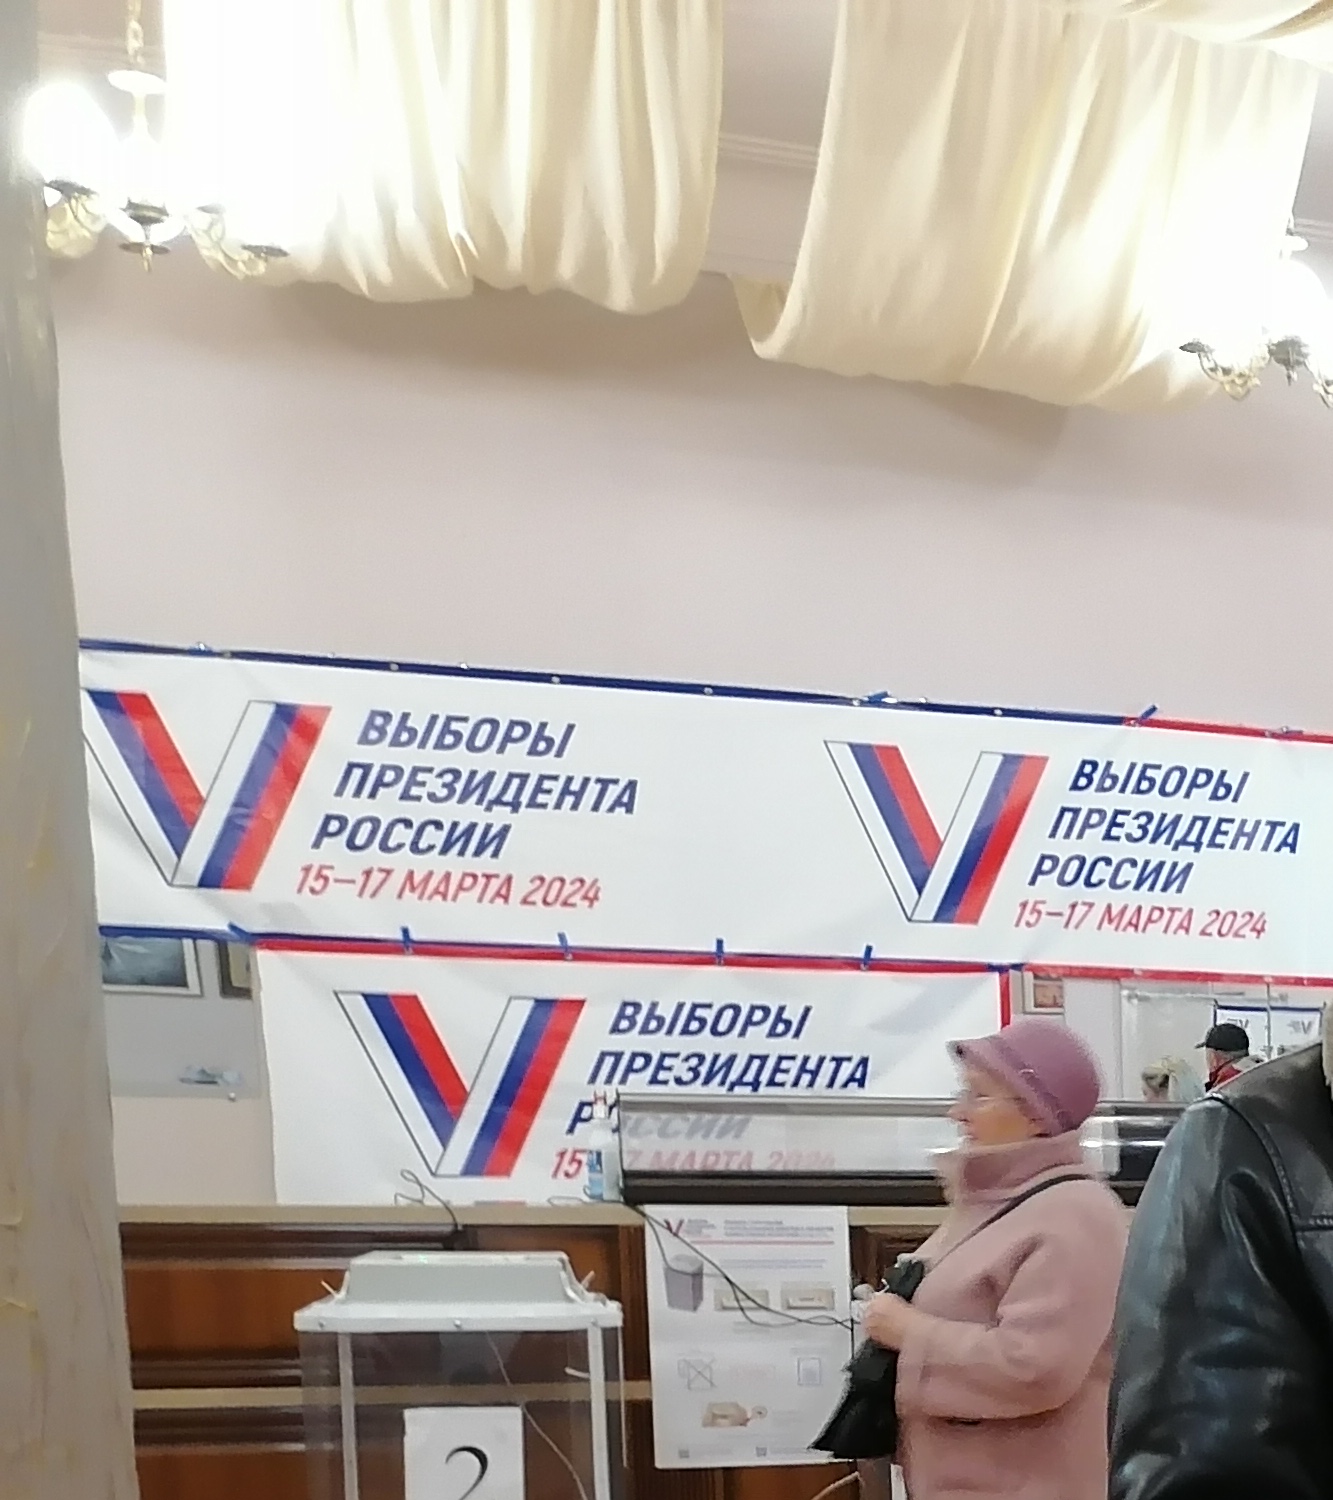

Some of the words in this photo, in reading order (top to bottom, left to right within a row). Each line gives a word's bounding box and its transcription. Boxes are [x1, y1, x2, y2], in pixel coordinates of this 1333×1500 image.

[357, 708, 577, 760] ВЫБОРЫ
[333, 761, 638, 816] ПРЕЗИДЕНТА
[1068, 757, 1251, 805] ВЫБОРЫ
[310, 811, 512, 860] РОССИИ
[1047, 804, 1303, 856] ПРЕЗИДЕНТА
[397, 866, 514, 905] МАРТА
[518, 873, 604, 910] 2024
[1026, 850, 1196, 896] РОССИИ
[1098, 901, 1196, 937] МАРТА
[1200, 906, 1269, 941] 2024
[608, 998, 813, 1041] ВЫБОРЫ
[587, 1048, 872, 1094] ПРЕЗИДЕНТА
